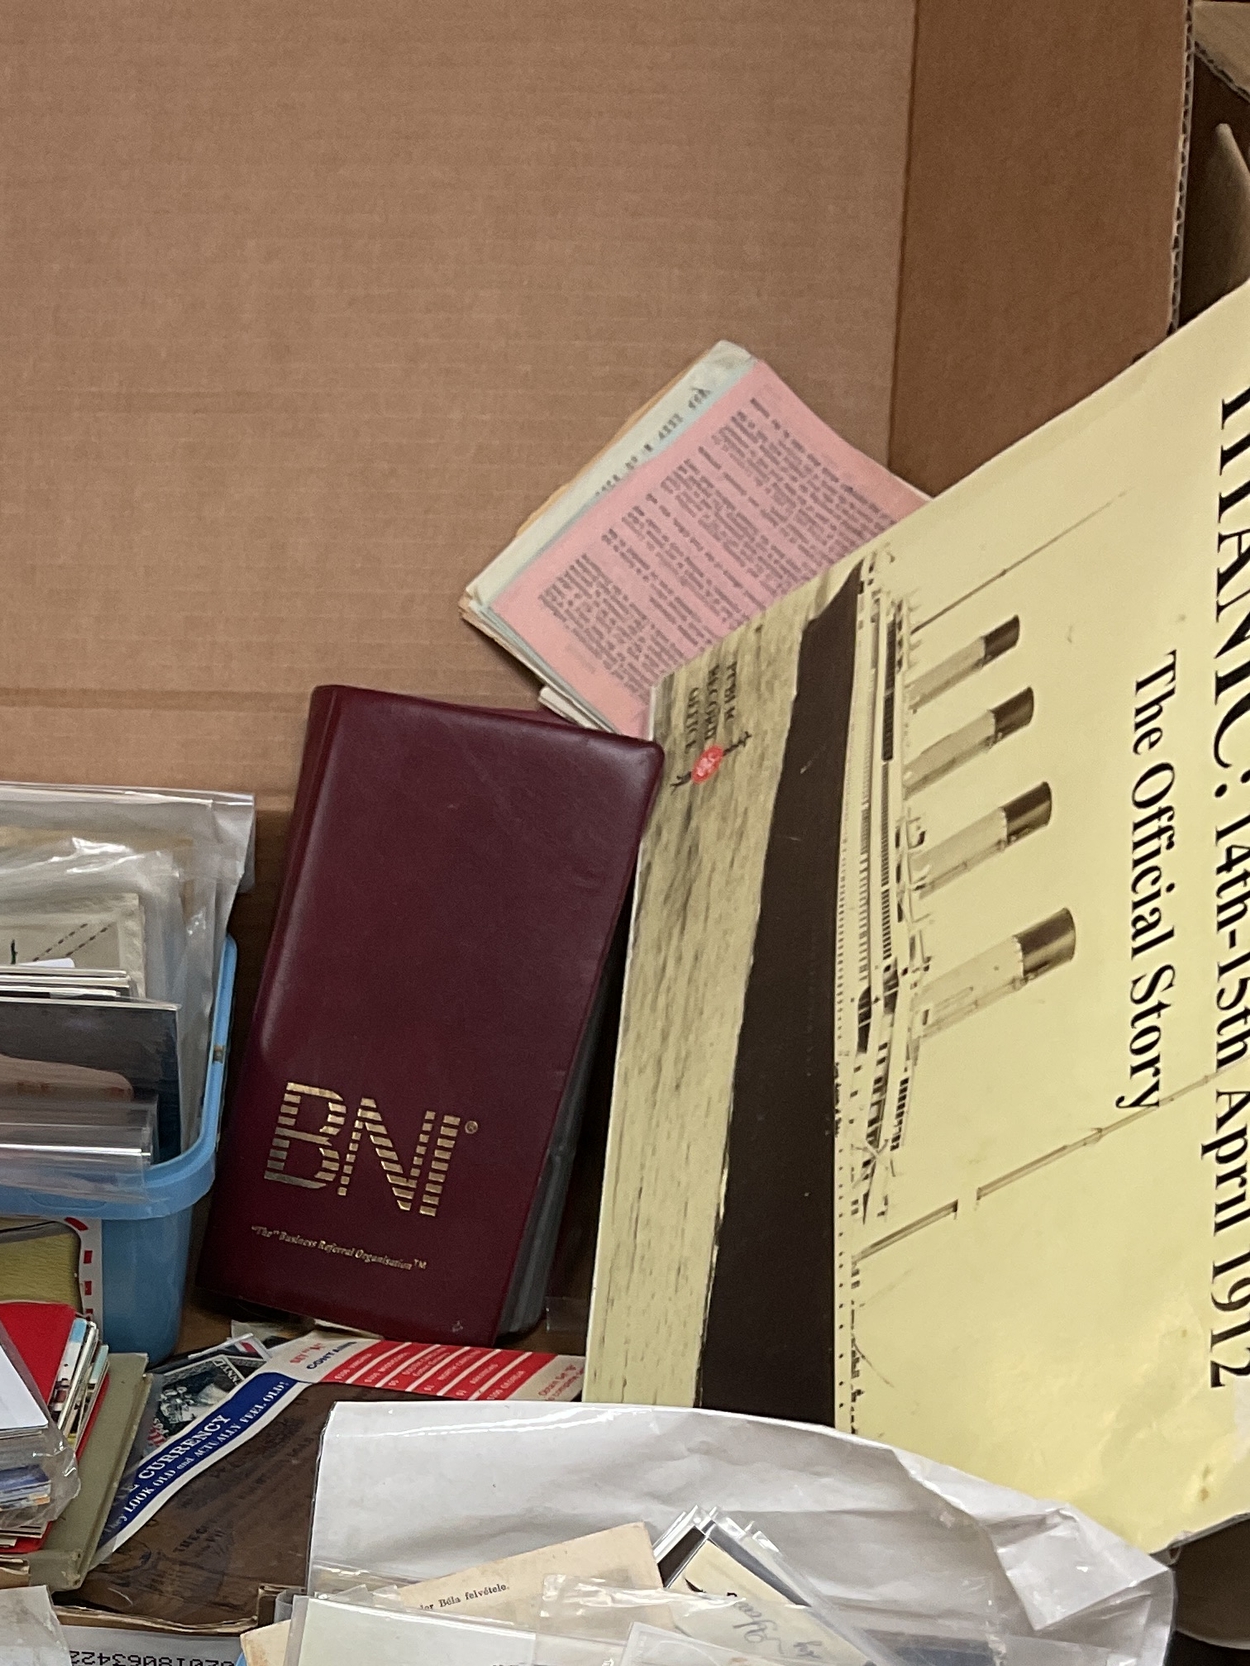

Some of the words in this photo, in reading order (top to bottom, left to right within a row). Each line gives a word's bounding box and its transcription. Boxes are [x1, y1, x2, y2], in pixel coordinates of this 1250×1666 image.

[1133, 649, 1177, 756] The
[1130, 761, 1176, 960] Official
[1115, 964, 1177, 1112] Story
[318, 1240, 355, 1258] Referral
[123, 1486, 156, 1513] LOOK
[152, 1468, 177, 1488] OLD
[176, 1456, 196, 1471] and
[194, 1423, 243, 1459] ACTUALLY
[239, 1402, 268, 1425] FEEL
[137, 1413, 232, 1481] CURRENCY
[438, 1596, 461, 1608] Béla
